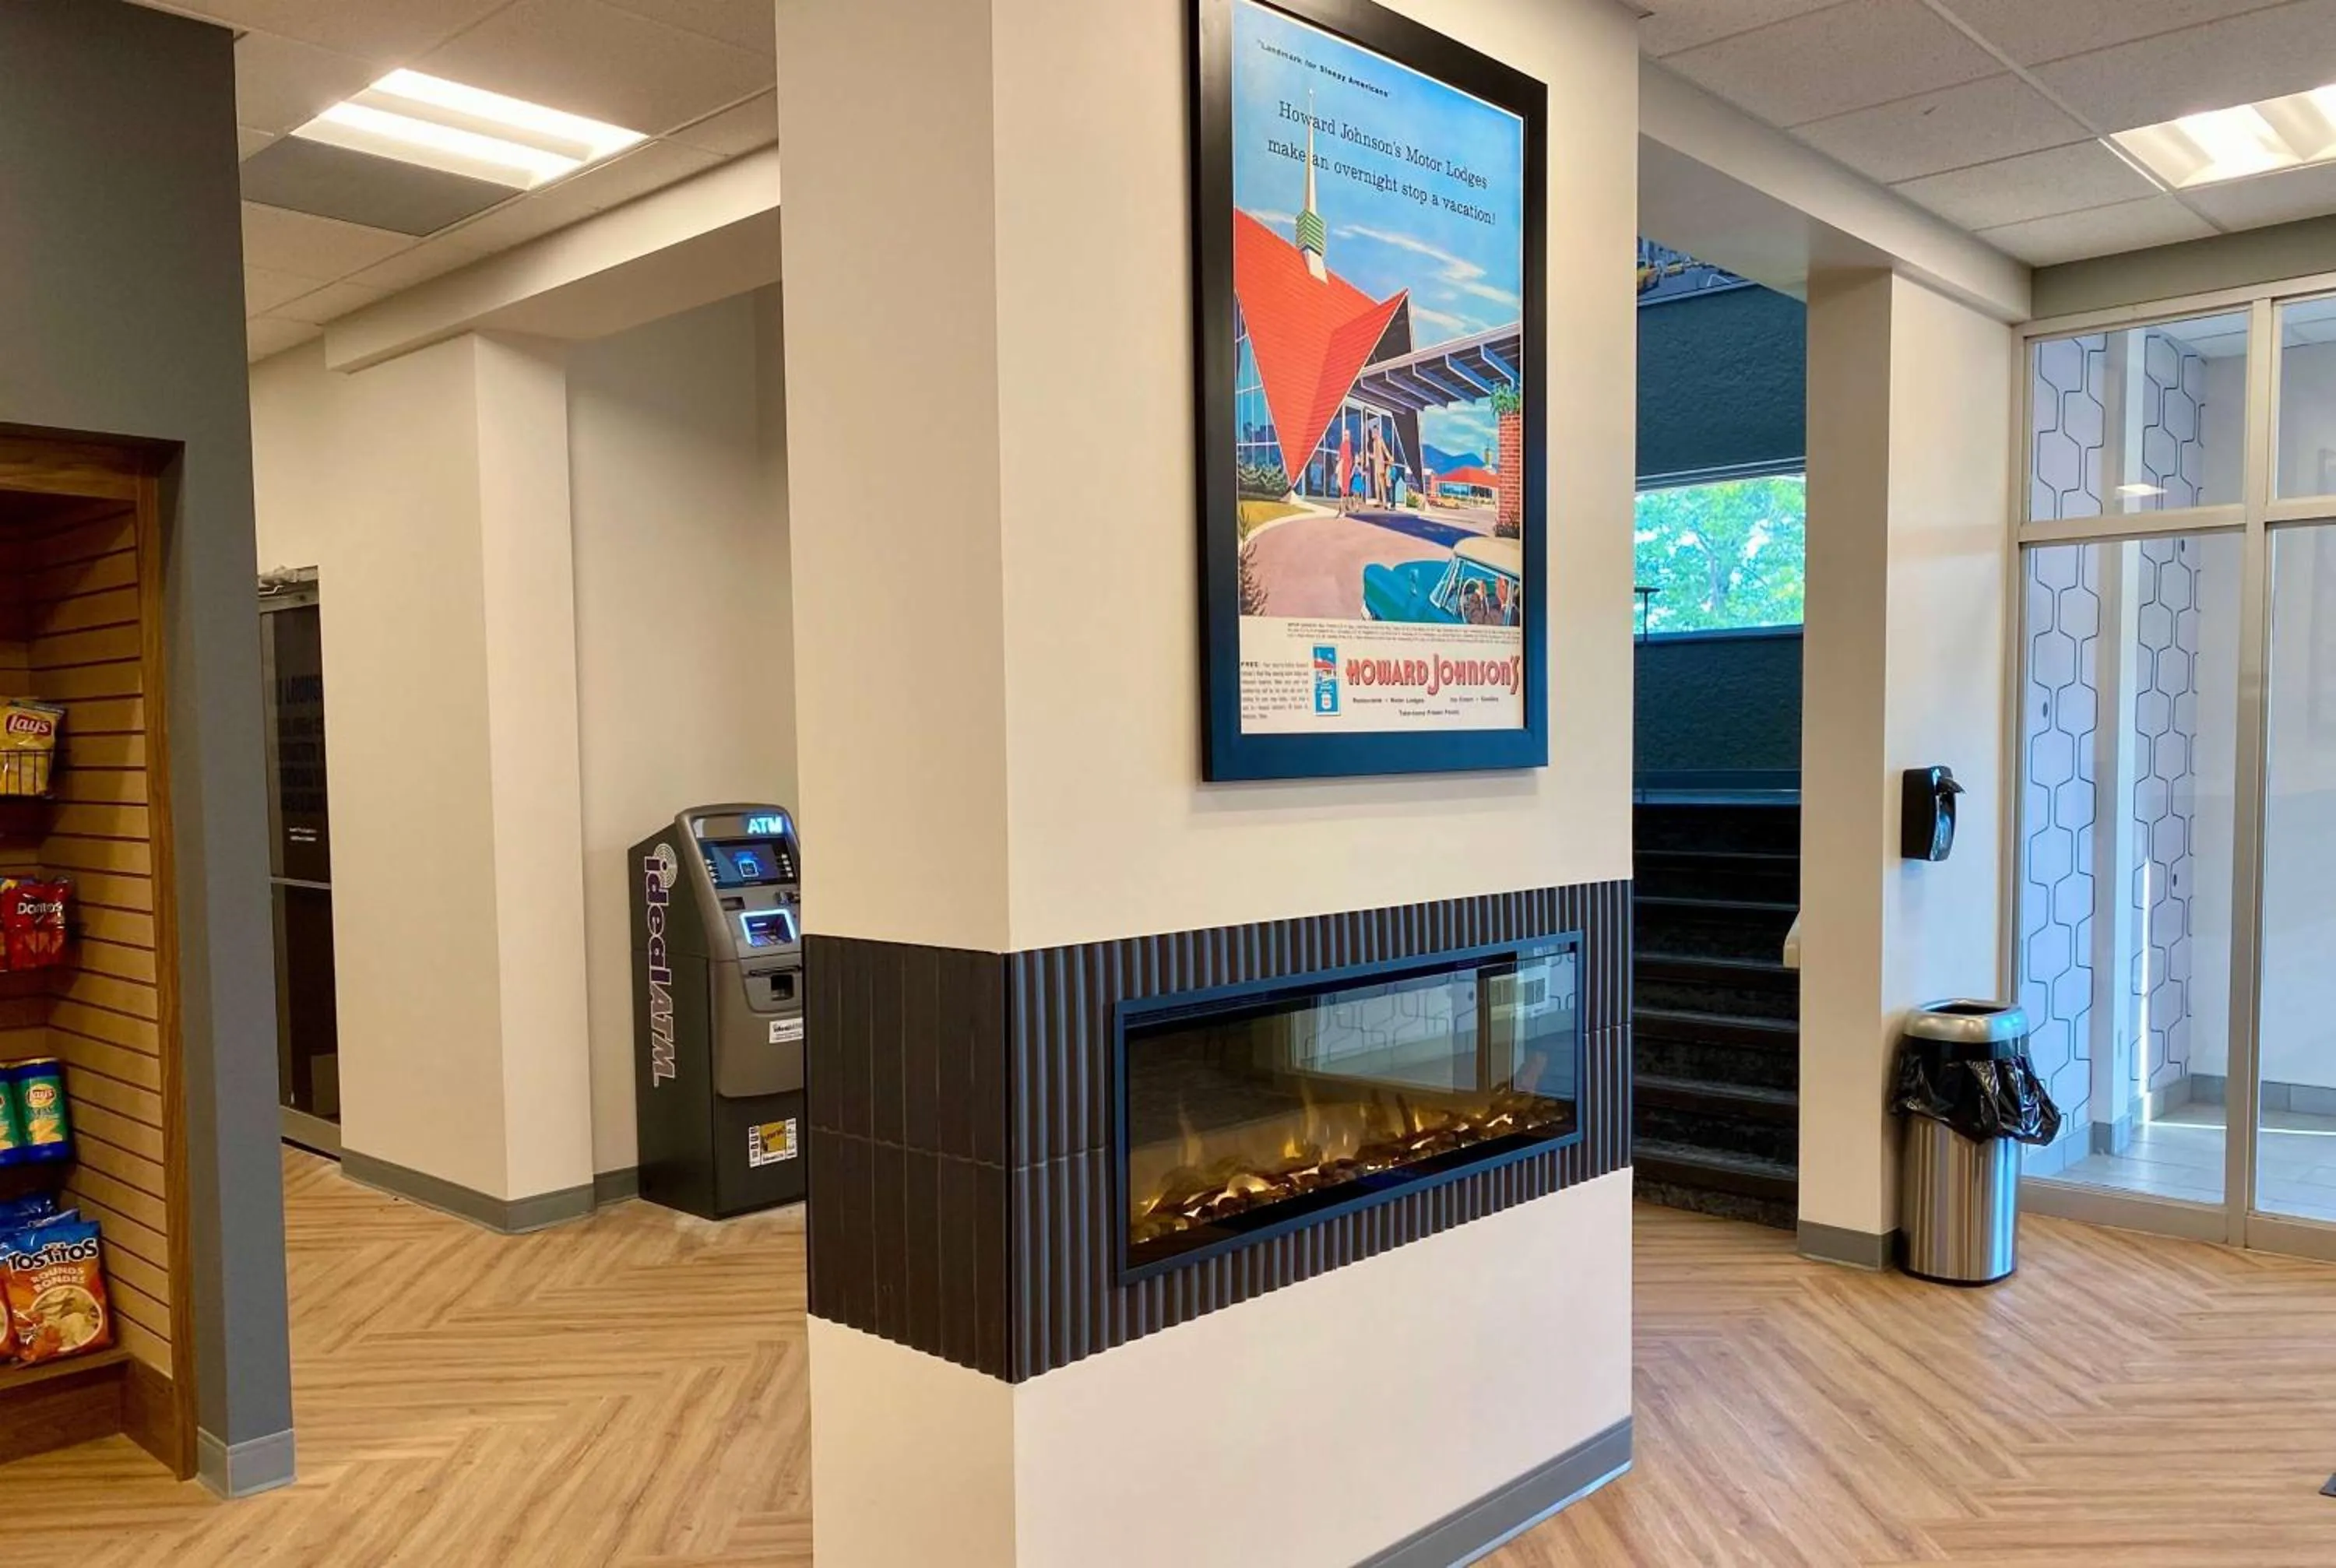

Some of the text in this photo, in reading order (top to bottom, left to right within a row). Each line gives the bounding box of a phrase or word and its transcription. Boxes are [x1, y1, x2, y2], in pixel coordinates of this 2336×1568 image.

[1304, 59, 1317, 69] for
[1320, 65, 1346, 82] Sleepy
[1279, 100, 1487, 190] Howard Johnson's Motor Lodges
[1268, 139, 1496, 225] make an overnight stop a vacation!
[1346, 659, 1429, 686] HOWARD
[748, 815, 783, 835] ATM
